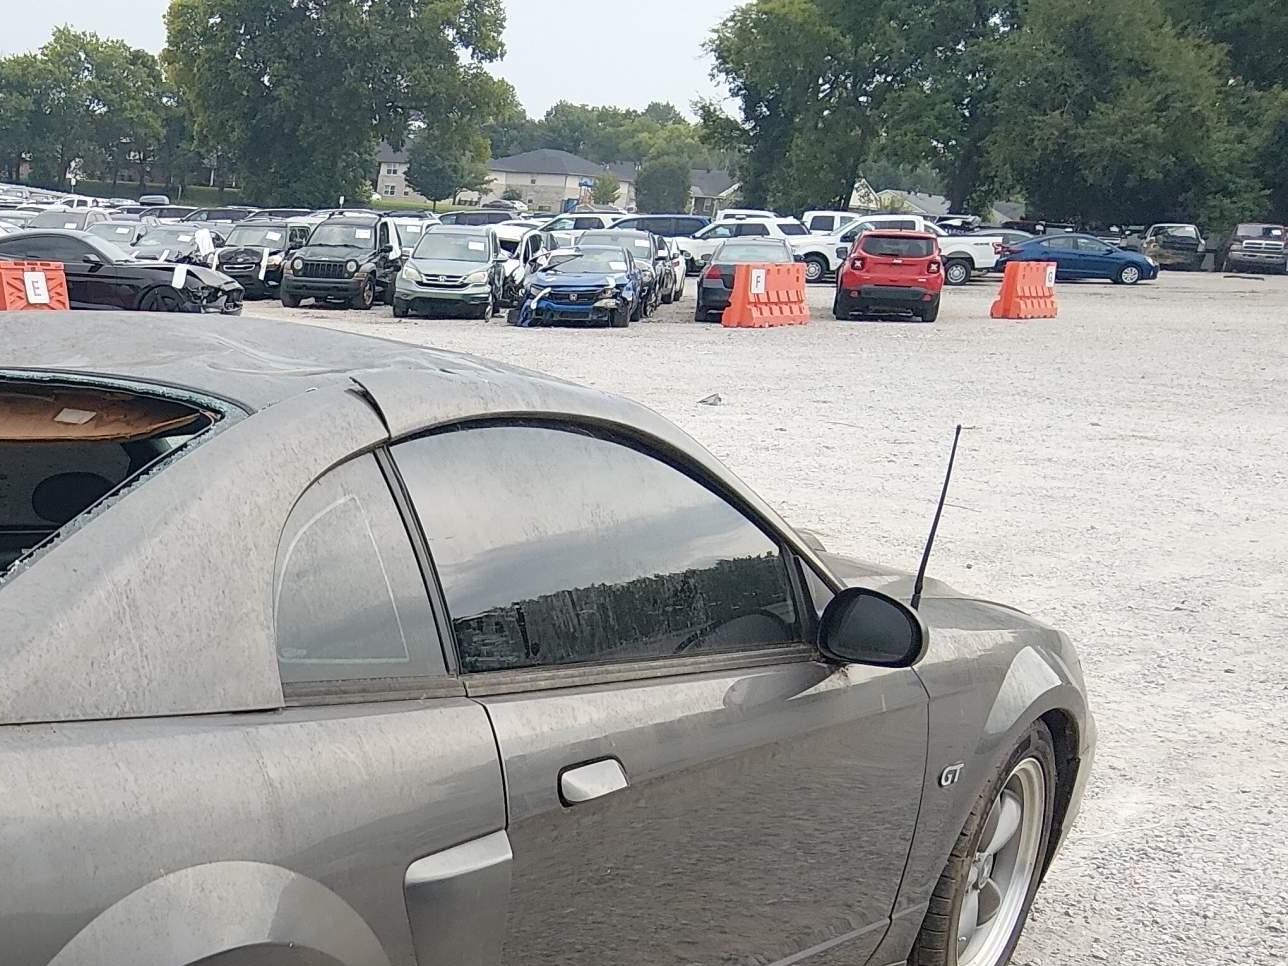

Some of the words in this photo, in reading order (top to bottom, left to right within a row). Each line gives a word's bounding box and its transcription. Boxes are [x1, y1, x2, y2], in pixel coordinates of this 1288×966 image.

[32, 280, 42, 297] E
[755, 275, 761, 289] F
[938, 763, 965, 787] GT
